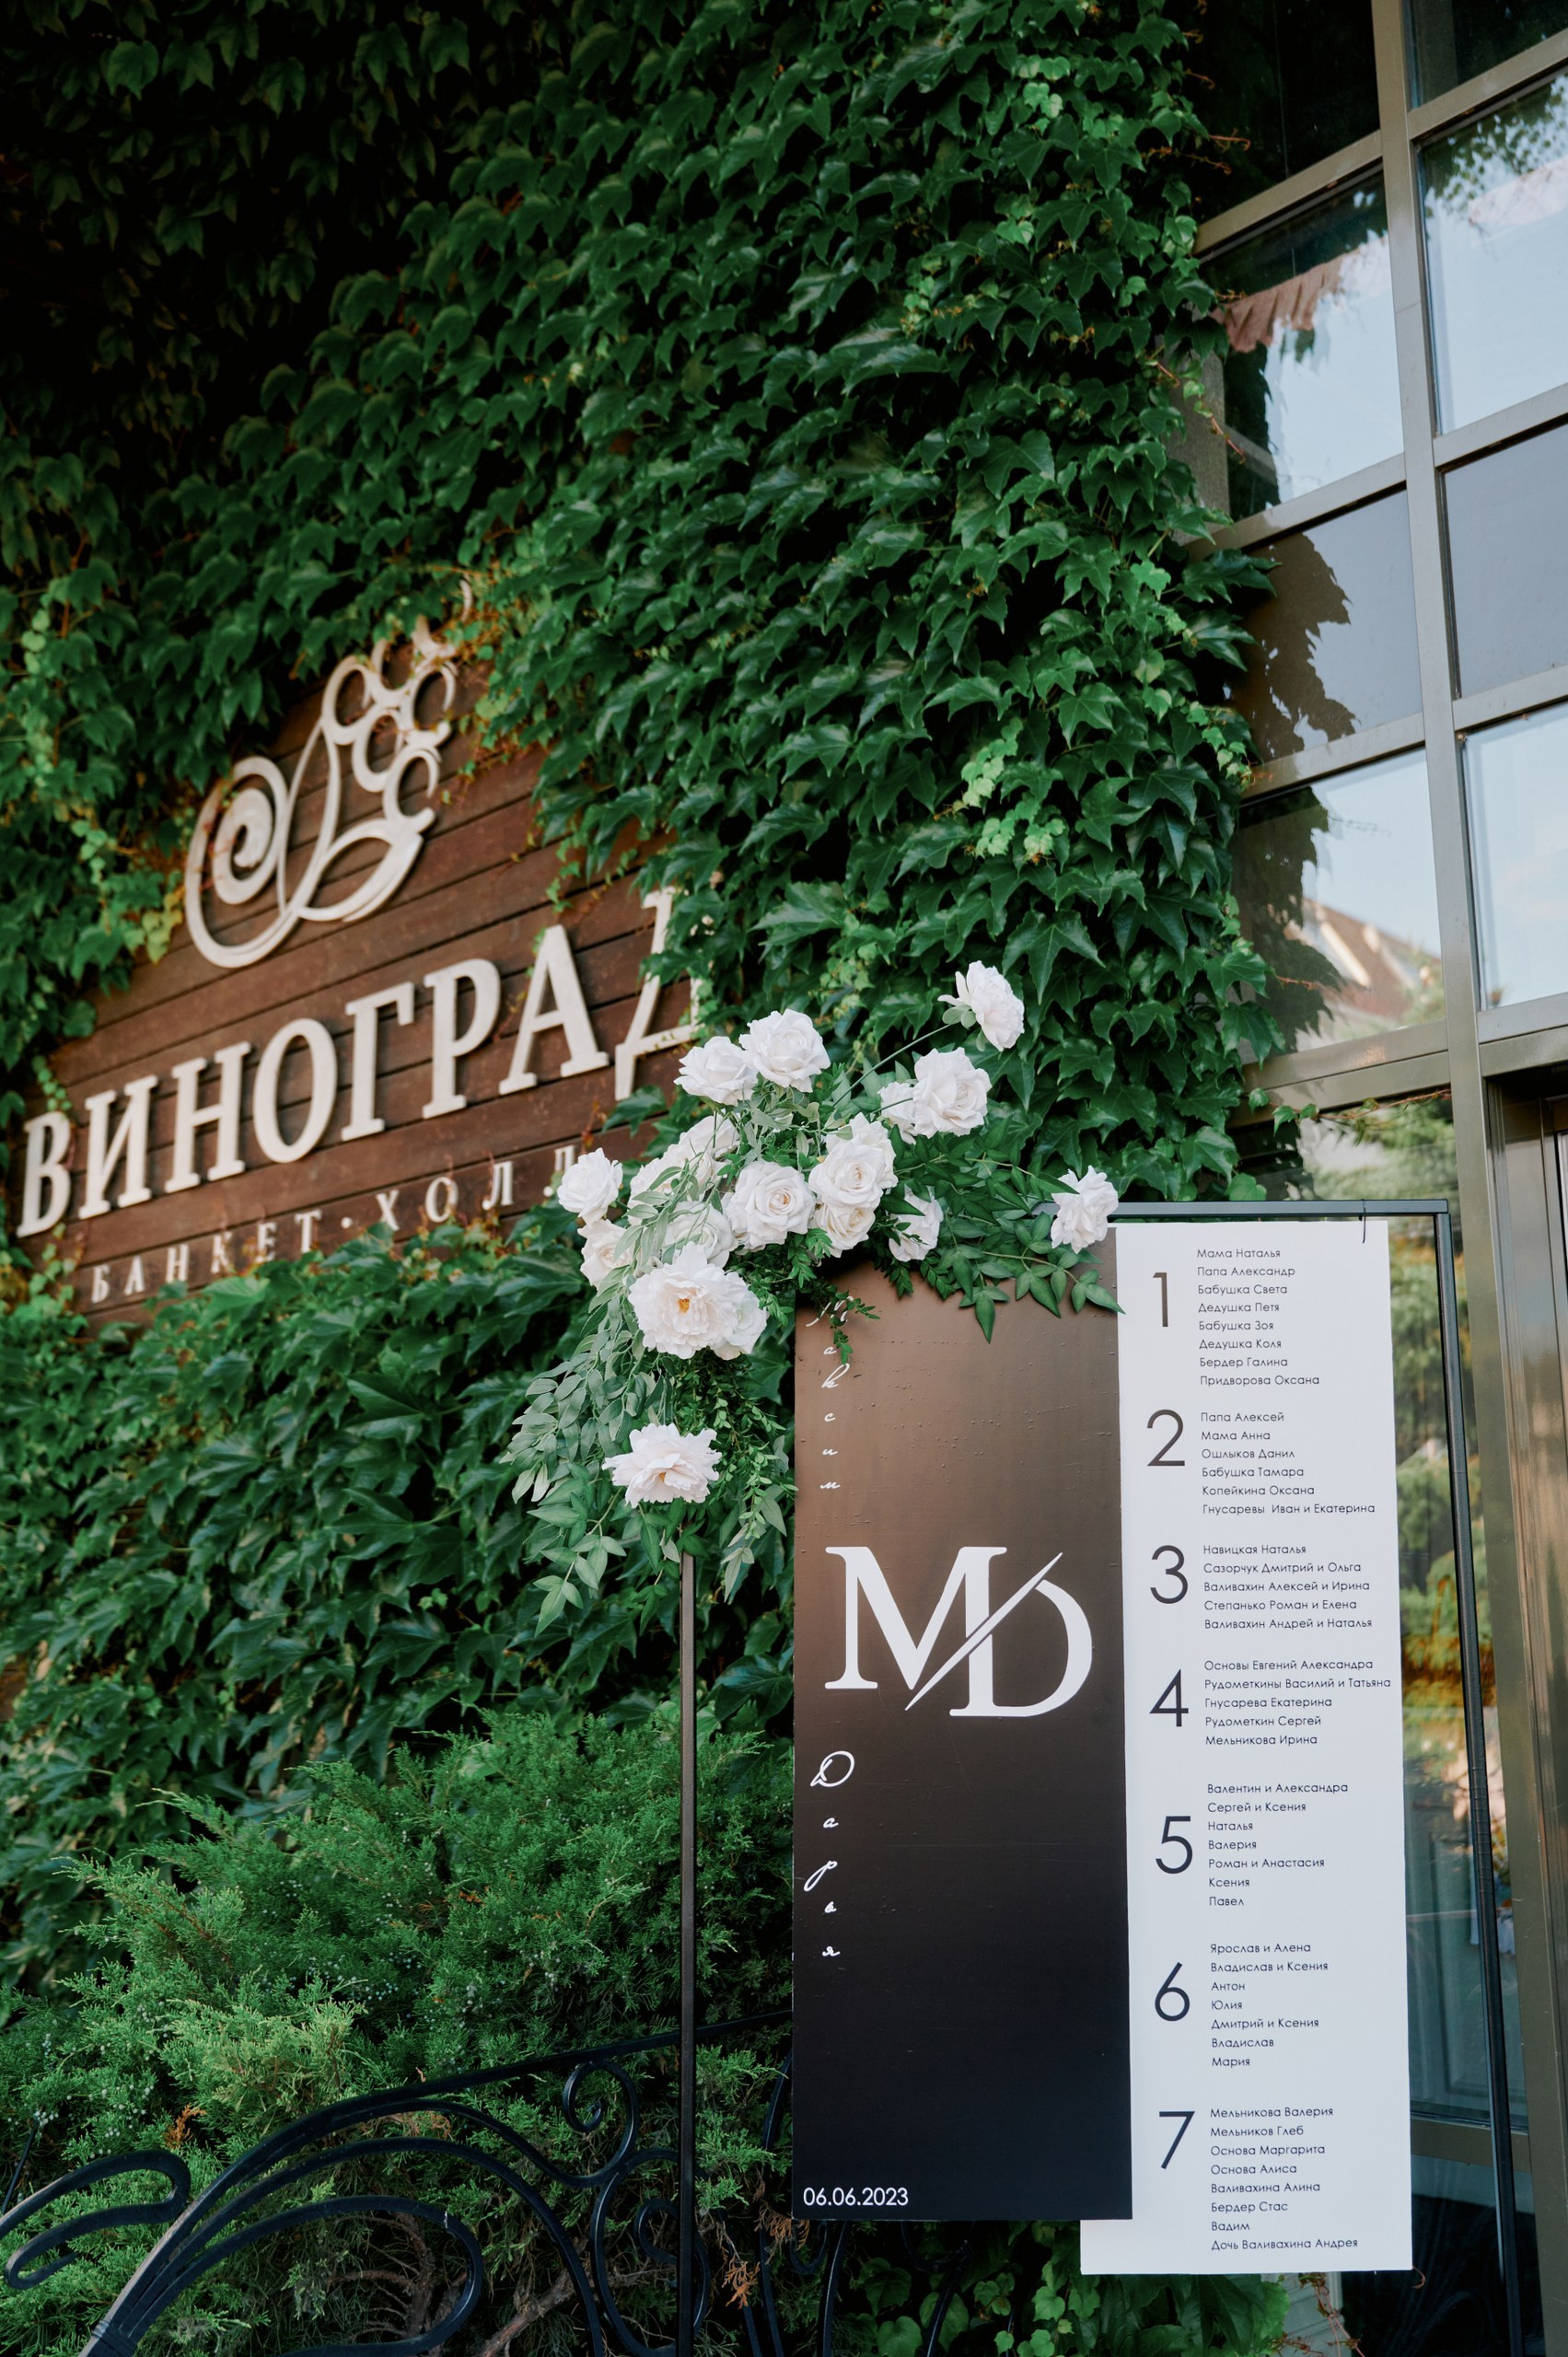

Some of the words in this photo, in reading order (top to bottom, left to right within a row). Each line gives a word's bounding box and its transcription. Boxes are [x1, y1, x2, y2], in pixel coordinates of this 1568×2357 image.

[1196, 1248, 1233, 1259] Мама
[1236, 1248, 1281, 1259] Наталья
[1197, 1266, 1227, 1277] Папа
[1230, 1266, 1295, 1278] Александр
[1198, 1283, 1250, 1296] Бабушка
[1253, 1283, 1288, 1295] Света
[1153, 1272, 1168, 1327] 1
[1197, 1302, 1252, 1315] Дедушка
[1254, 1302, 1280, 1312] Петя
[1198, 1319, 1251, 1332] Бабушка
[1254, 1319, 1274, 1331] Зоя
[1198, 1339, 1253, 1352] Дедушка
[1256, 1338, 1282, 1349] Коля
[1199, 1356, 1244, 1369] Бердер
[1247, 1356, 1288, 1367] Галина
[1200, 1375, 1272, 1387] Придворова
[1273, 1375, 1320, 1386] Оксана
[1201, 1411, 1231, 1422] Папа
[1234, 1411, 1284, 1422] Алексей
[1147, 1410, 1185, 1466] 2
[1201, 1431, 1237, 1441] Мама
[1240, 1431, 1271, 1441] Анна
[1201, 1448, 1256, 1459] Ошлыков
[1258, 1448, 1295, 1460] Данил
[1202, 1466, 1255, 1480] Бабушка
[1257, 1467, 1305, 1479] Тамара
[1202, 1485, 1266, 1496] Копейкина
[1269, 1484, 1315, 1496] Оксана
[1202, 1504, 1265, 1516] Гнусаревы
[1272, 1504, 1301, 1514] Иван
[1303, 1505, 1311, 1514] и
[1313, 1503, 1376, 1515] Екатерина
[1202, 1544, 1258, 1556] Навицкая
[1260, 1544, 1307, 1554] Наталья
[1150, 1545, 1188, 1604] 3
[1202, 1562, 1259, 1575] Сазорчук
[1260, 1562, 1314, 1575] Дмитрий
[1317, 1564, 1325, 1573] и
[1327, 1562, 1362, 1573] Ольга
[1203, 1581, 1265, 1592] Валивахин
[1268, 1581, 1318, 1592] Алексей
[1321, 1583, 1329, 1591] и
[1331, 1581, 1370, 1593] Ирина
[1203, 1599, 1267, 1611] Степанько
[1269, 1599, 1308, 1610] Роман
[1322, 1599, 1357, 1610] Елена
[1204, 1619, 1266, 1630] Валивахин
[1269, 1618, 1314, 1631] Андрей
[1317, 1620, 1324, 1629] и
[1327, 1618, 1373, 1629] Наталья
[1203, 1660, 1249, 1671] Основы
[1252, 1659, 1297, 1671] Евгений
[1300, 1660, 1374, 1671] Александра
[1204, 1678, 1282, 1691] Рудометкины
[1284, 1678, 1335, 1689] Василий
[1337, 1679, 1345, 1688] и
[1347, 1678, 1391, 1688] Татьяна
[1149, 1669, 1189, 1727] 4
[1204, 1697, 1268, 1710] Гнусарева
[1271, 1697, 1332, 1710] Екатерина
[1205, 1716, 1275, 1729] Рудометкин
[1277, 1715, 1321, 1728] Сергей
[1205, 1736, 1276, 1746] Мельникова
[1279, 1735, 1318, 1747] Ирина
[1207, 1783, 1261, 1794] Валентин
[1264, 1785, 1272, 1794] и
[1274, 1782, 1349, 1794] Александра
[1207, 1802, 1251, 1815] Сергей
[1254, 1804, 1262, 1812] и
[1264, 1802, 1307, 1812] Ксения
[1207, 1820, 1254, 1831] Наталья
[1156, 1816, 1192, 1874] 5
[1208, 1840, 1257, 1852] Валерия
[1208, 1858, 1249, 1869] Роман
[1250, 1860, 1259, 1868] и
[1261, 1858, 1325, 1868] Анастасия
[1208, 1877, 1250, 1887] Ксения
[1209, 1896, 1245, 1907] Павел
[1210, 1943, 1260, 1956] Ярослав
[1263, 1945, 1271, 1953] и
[1273, 1943, 1311, 1953] Алена
[1210, 1962, 1273, 1973] Владислав
[1276, 1963, 1284, 1971] и
[1286, 1961, 1329, 1971] Ксения
[1155, 1962, 1190, 2022] 6
[1211, 1981, 1246, 1991] Антон
[1211, 1999, 1243, 2011] Юлия
[1211, 2018, 1264, 2031] Дмитрий
[1267, 2020, 1275, 2028] и
[1277, 2017, 1319, 2028] Ксения
[1212, 2038, 1274, 2049] Владислав
[1211, 2057, 1250, 2069] Мария
[1210, 2107, 1282, 2119] Мельникова
[1284, 2107, 1334, 2119] Валерия
[1210, 2127, 1274, 2137] Мельников
[1276, 2124, 1305, 2136] Глеб
[1159, 2111, 1195, 2169] 7
[1210, 2145, 1256, 2156] Основа
[1259, 2145, 1326, 2157] Маргарита
[1210, 2164, 1257, 2176] Основа
[1259, 2164, 1297, 2174] Алиса
[1211, 2183, 1281, 2194] Валивахина
[1283, 2182, 1320, 2192] Алина
[803, 2187, 909, 2206] 06.06.2023
[1211, 2201, 1256, 2214] Бердер
[1259, 2200, 1288, 2212] Стас
[1211, 2221, 1250, 2232] Вадим
[1211, 2239, 1239, 2252] Дочь
[1241, 2239, 1312, 2250] Валивахина
[1314, 2238, 1358, 2250] Андрея
